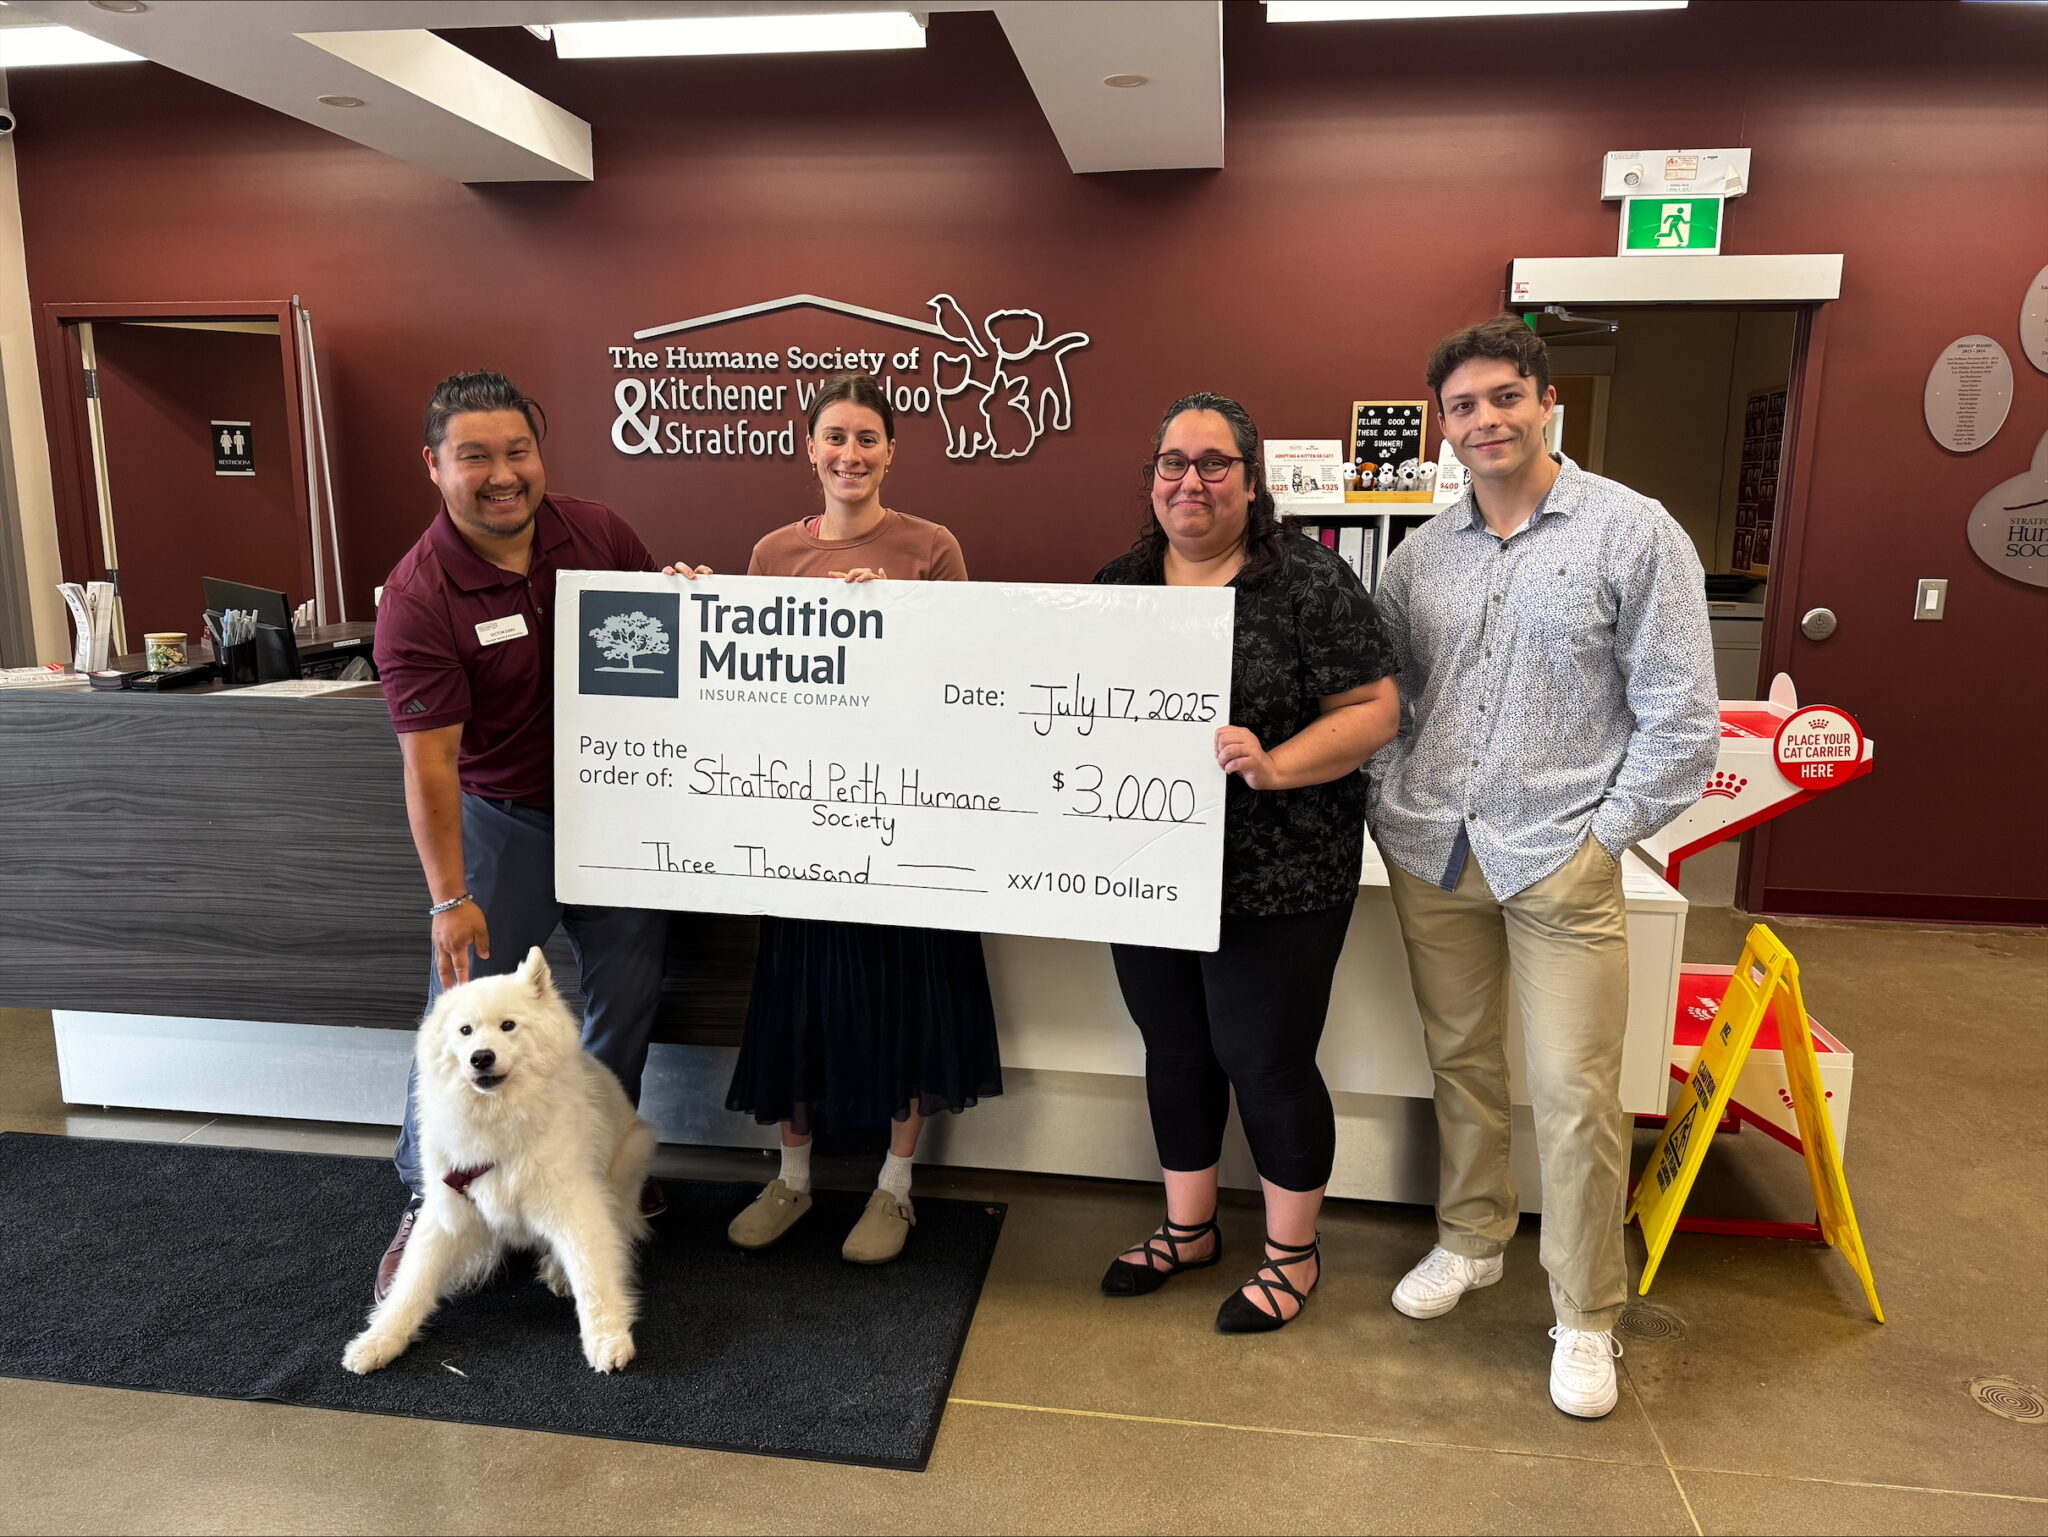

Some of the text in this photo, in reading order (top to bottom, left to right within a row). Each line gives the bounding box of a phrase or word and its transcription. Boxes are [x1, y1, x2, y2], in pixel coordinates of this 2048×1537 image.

[608, 346, 919, 375] The Humane Society of
[611, 374, 930, 455] & Kitchener Wloo
[1358, 418, 1420, 426] FELINE GOOD ON
[665, 419, 794, 456] Stratford
[1357, 429, 1418, 437] THESE DOG DAYS
[1374, 440, 1403, 449] SUMMER!
[1321, 483, 1339, 491] $325
[1440, 482, 1459, 490] $400
[690, 593, 883, 639] Tradition
[699, 640, 846, 684] Mutual
[699, 688, 870, 707] INSURANCE COMPANY
[944, 684, 1005, 707] Date:
[1030, 672, 1096, 736] July
[1148, 689, 1220, 722] 2025
[580, 735, 687, 761] Pay to the
[1783, 745, 1851, 759] CAT CARRIER
[1787, 733, 1851, 746] PLACE YOUR
[579, 765, 639, 785] order
[646, 768, 673, 788] of:
[689, 753, 812, 800] Stratford
[828, 761, 887, 804] Perth
[901, 767, 1001, 811] Humane
[1801, 763, 1834, 778] HERE
[812, 804, 895, 846] Society
[641, 841, 1178, 902] Three Thousand xx/100 Dollars
[1697, 1059, 1716, 1099] CAUTION
